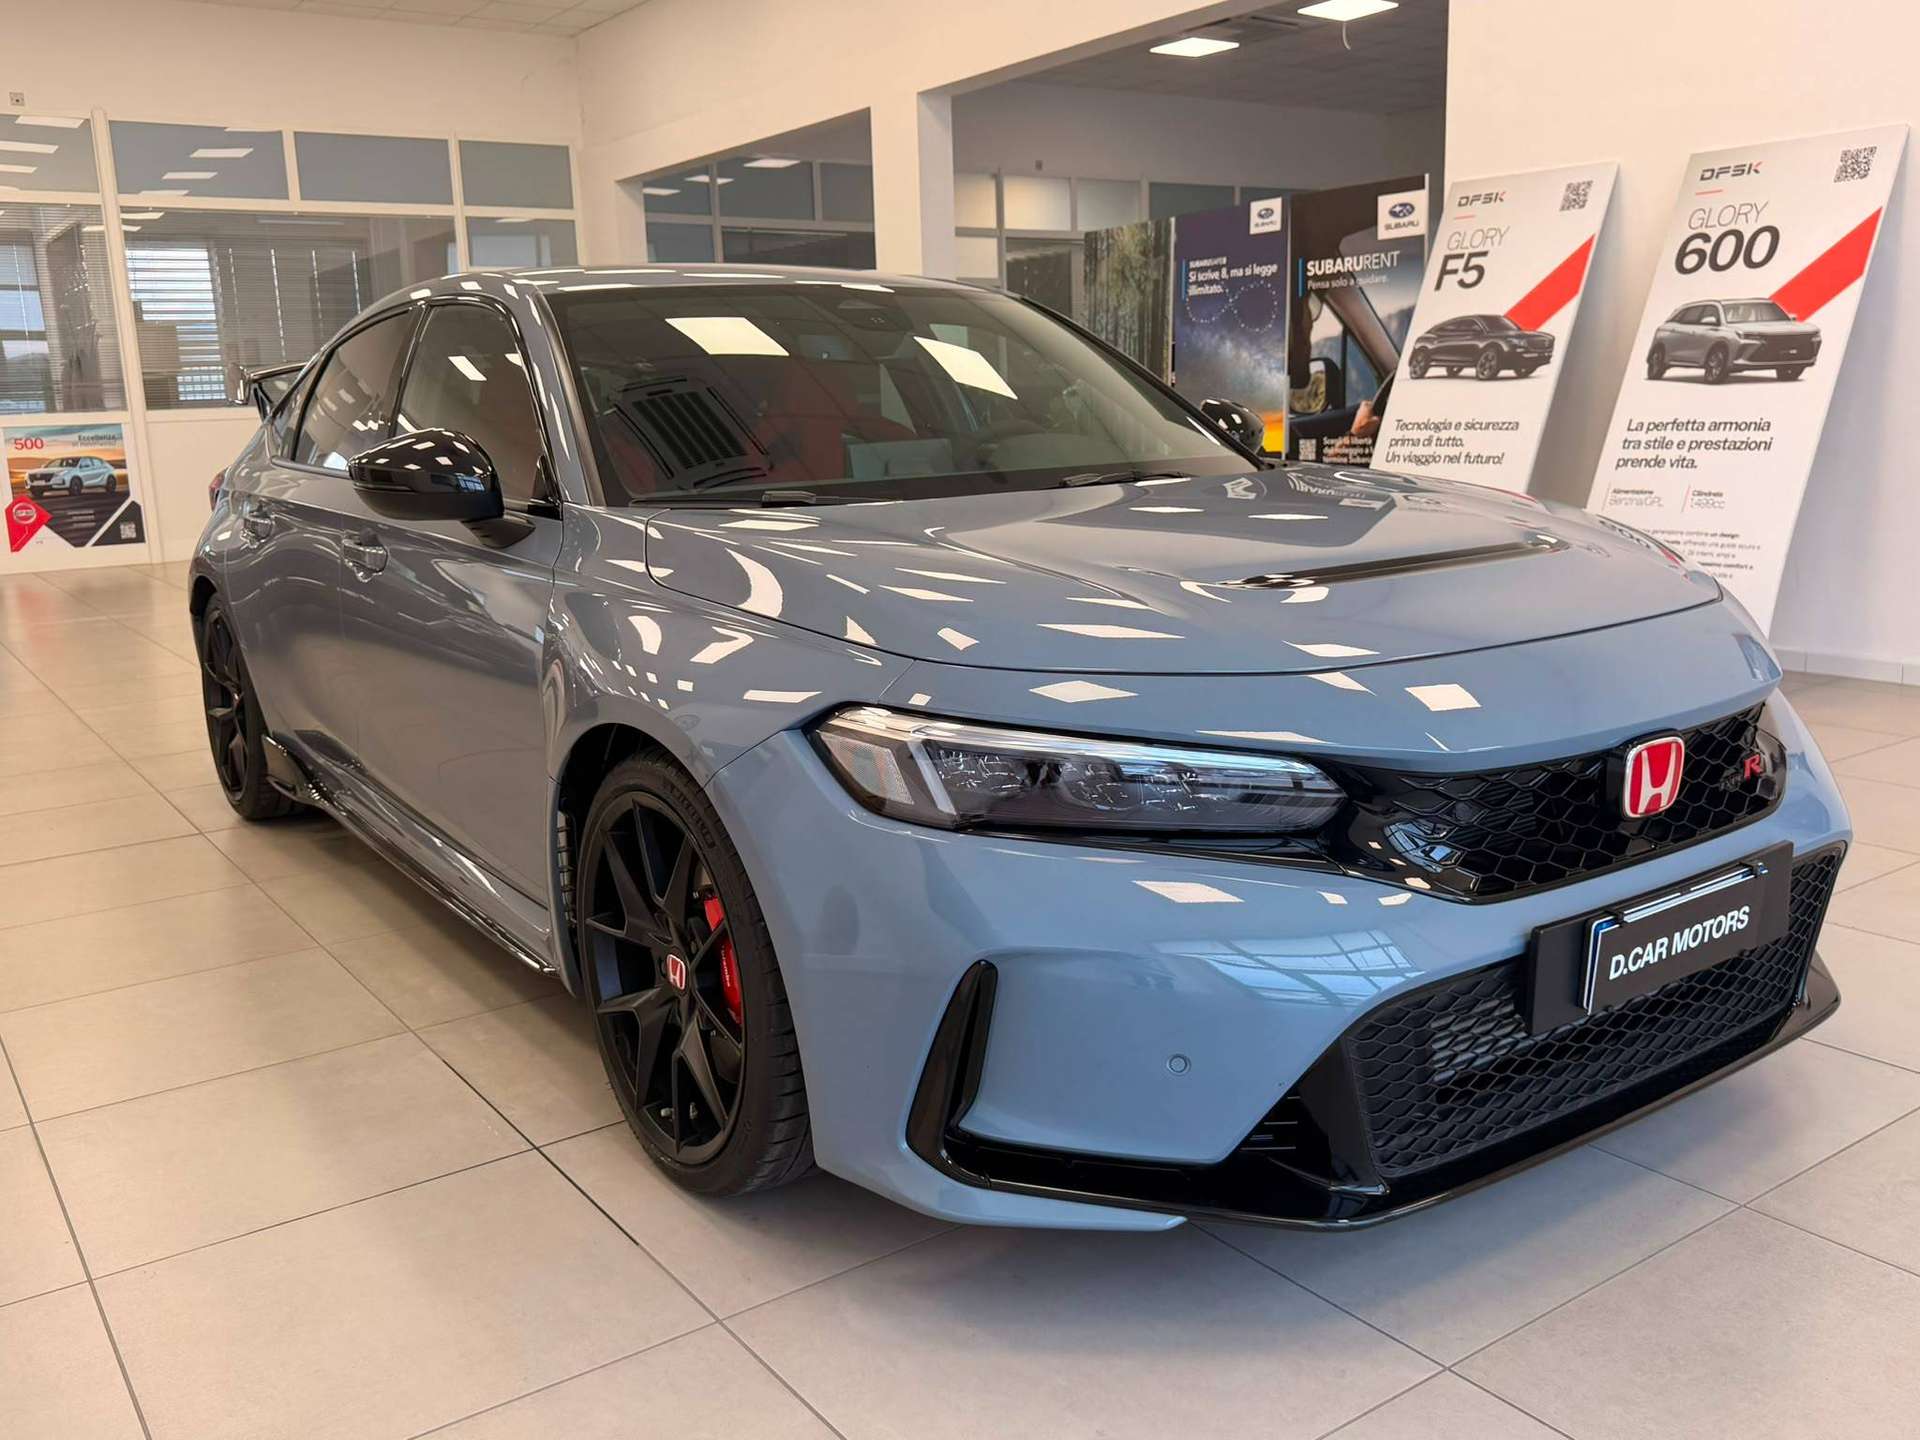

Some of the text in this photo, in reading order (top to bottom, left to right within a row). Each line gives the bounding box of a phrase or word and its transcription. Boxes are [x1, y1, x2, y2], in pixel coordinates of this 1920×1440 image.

[1700, 161, 1763, 182] DFSK
[1457, 191, 1506, 208] DFSK
[1688, 200, 1768, 231] GLORY
[1384, 220, 1420, 231] SUBARU
[1447, 225, 1511, 251] GLORY
[1674, 225, 1781, 275] 600
[1306, 250, 1401, 277] SUBARURENT
[1433, 251, 1489, 291] F5
[1188, 263, 1278, 282] Si scrive 8, ma si legge
[1307, 279, 1330, 290] Pensa
[1331, 276, 1348, 288] solo
[1395, 418, 1519, 433] Tecnologia e sicurezza
[1626, 418, 1771, 434] La perfetta armonia
[14, 438, 44, 450] 500
[1388, 434, 1464, 449] prima di tutto.
[1622, 436, 1774, 453] tra stile e prestazioni
[1385, 451, 1505, 466] Un viaggio nel futuro!
[1615, 454, 1698, 470] prende vita.
[1608, 905, 1751, 981] D.CAR MOTORS
